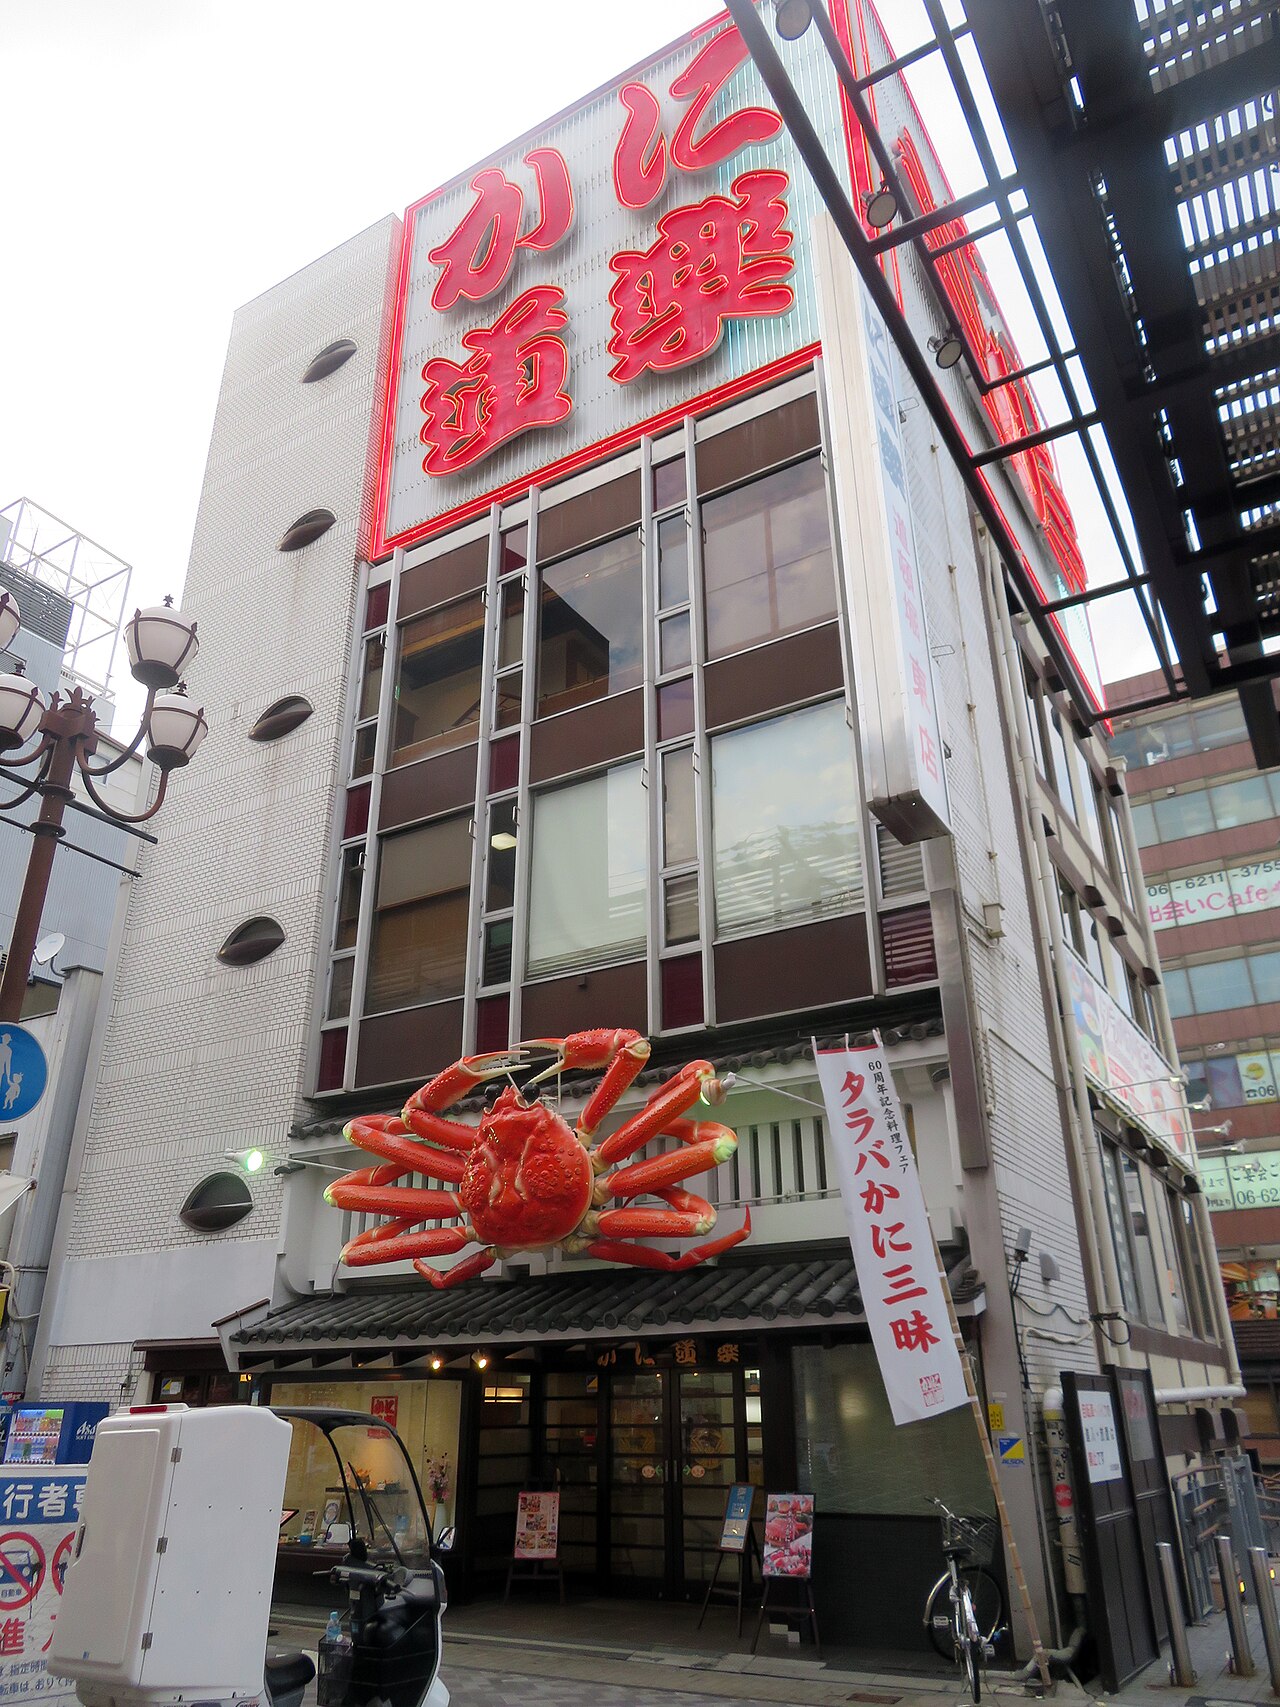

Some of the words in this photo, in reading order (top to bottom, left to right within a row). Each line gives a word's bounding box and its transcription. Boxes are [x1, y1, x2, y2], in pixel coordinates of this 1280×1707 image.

[429, 23, 785, 312] かに
[420, 168, 797, 478] 道楽
[839, 1070, 941, 1354] タラバかに三昧
[868, 1060, 908, 1174] 60周年記念料理フェア
